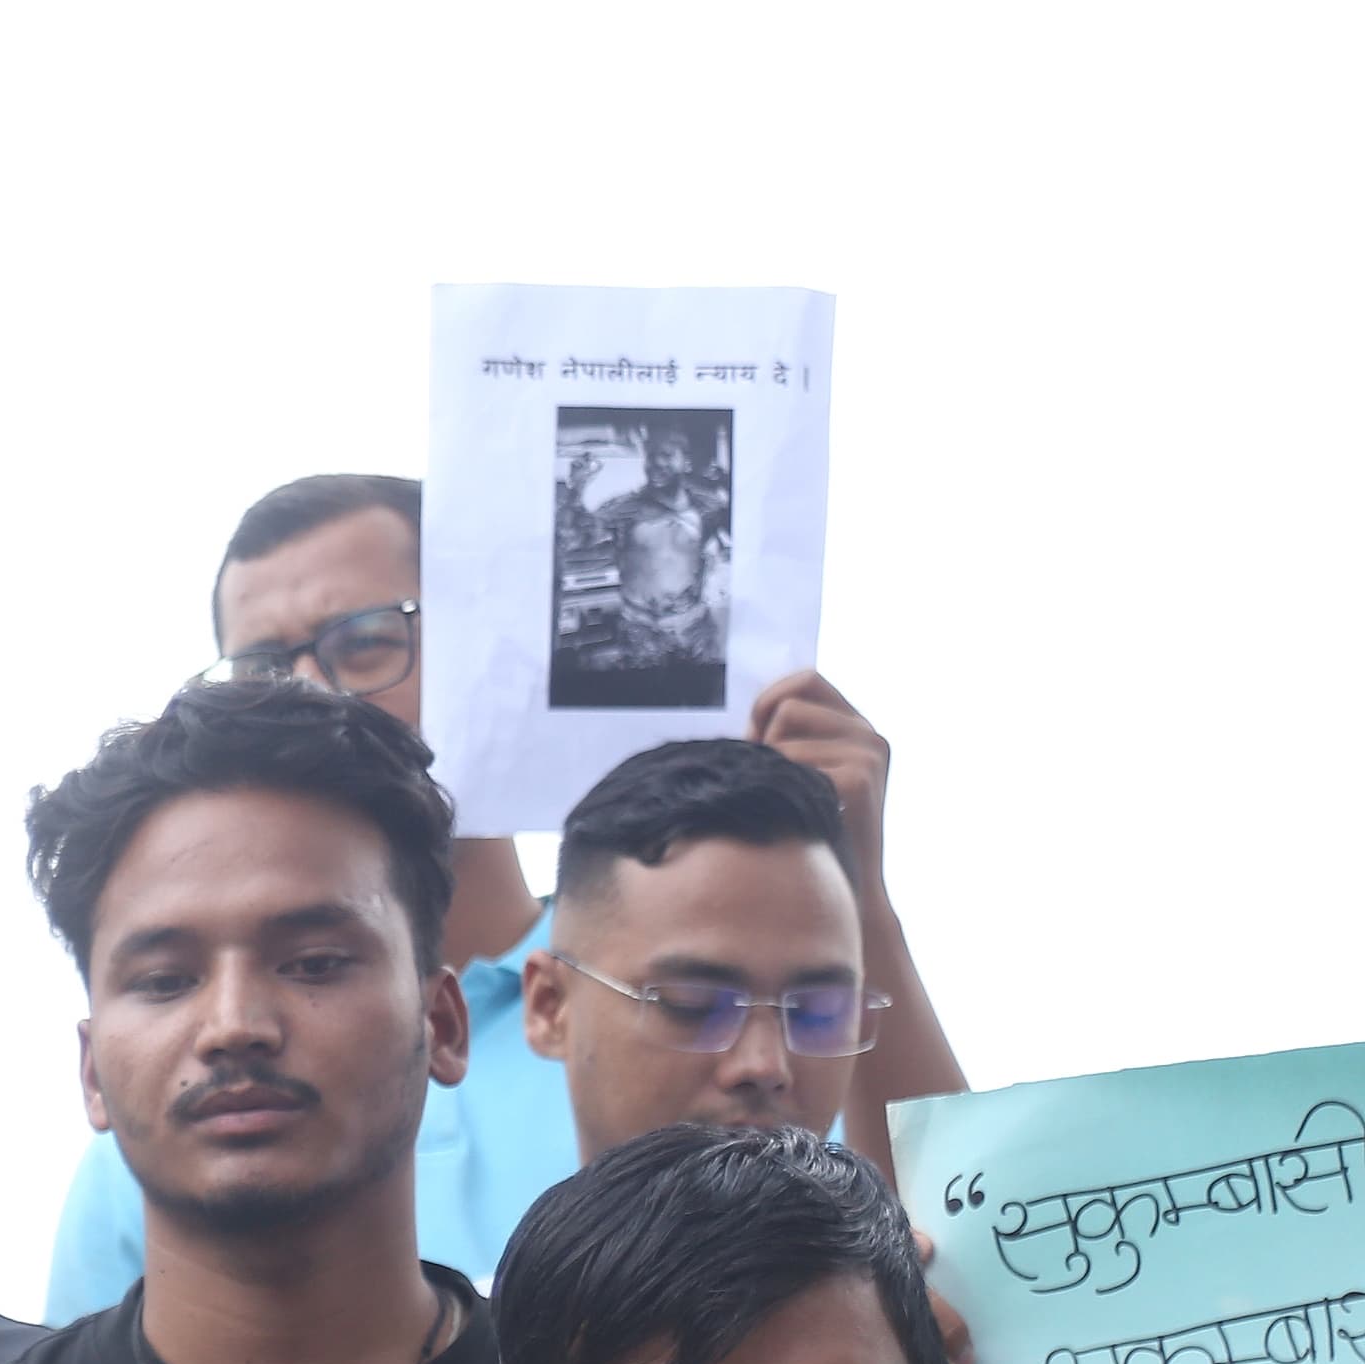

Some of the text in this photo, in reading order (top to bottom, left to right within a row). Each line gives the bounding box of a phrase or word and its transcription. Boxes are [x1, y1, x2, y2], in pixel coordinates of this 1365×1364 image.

[482, 354, 546, 381] गणेश
[696, 365, 758, 385] न्याय
[772, 361, 790, 387] दे
